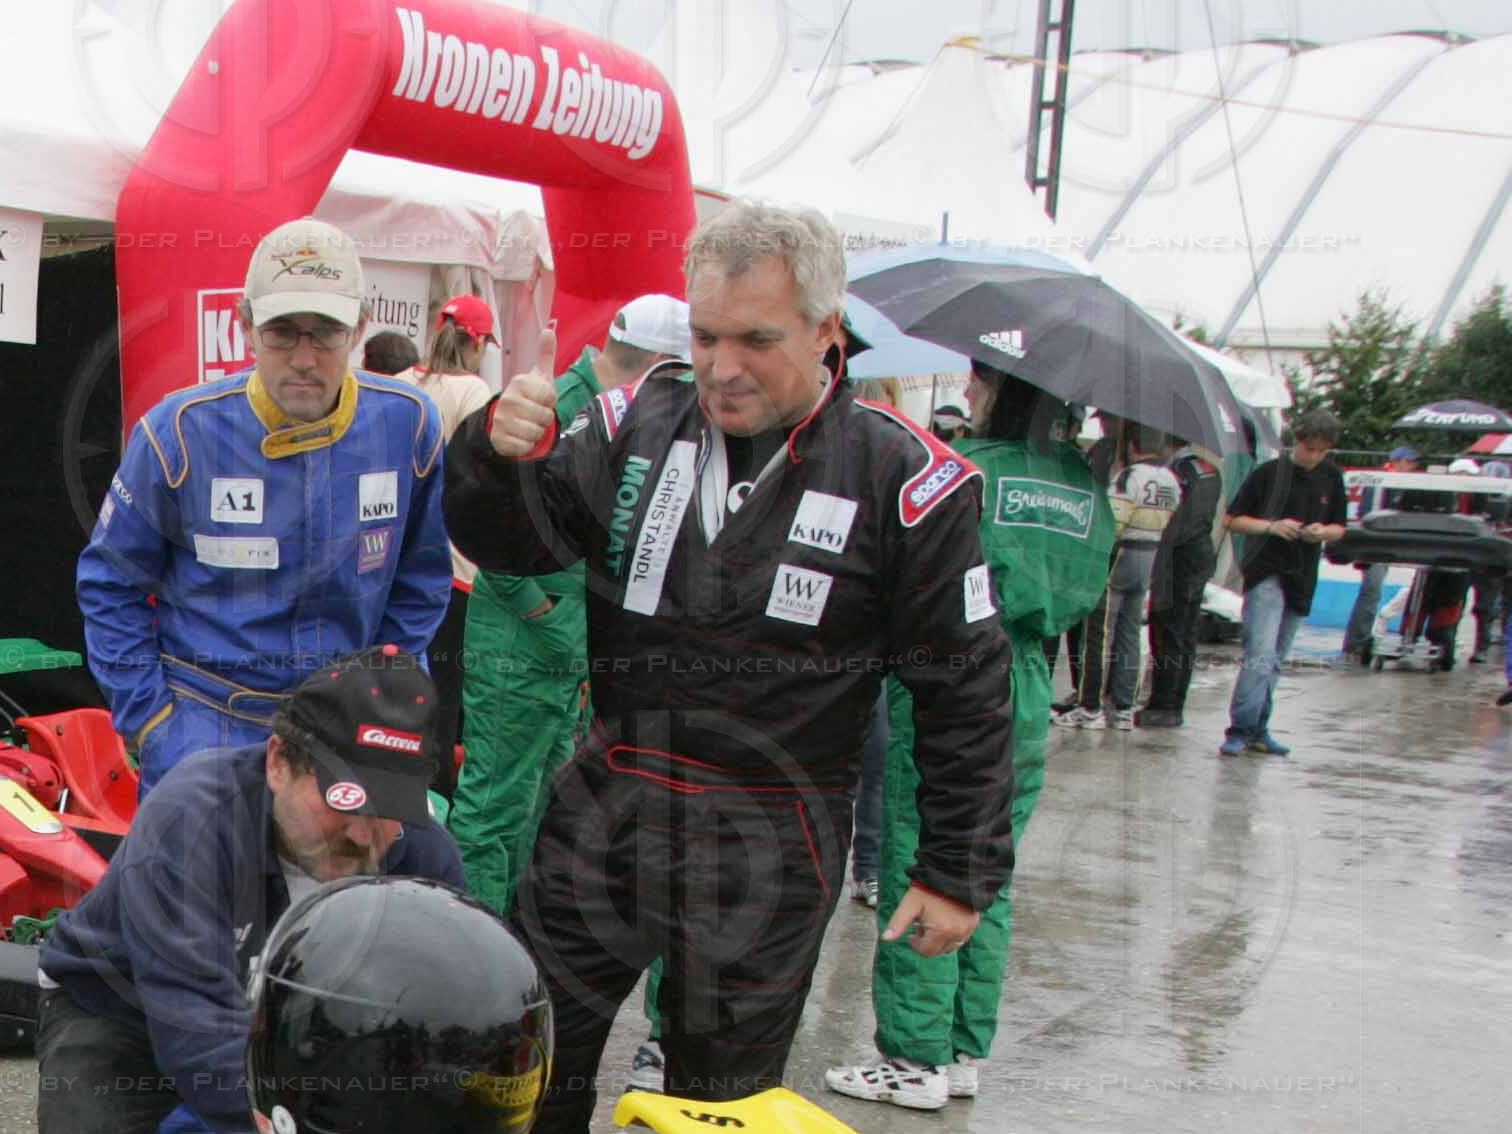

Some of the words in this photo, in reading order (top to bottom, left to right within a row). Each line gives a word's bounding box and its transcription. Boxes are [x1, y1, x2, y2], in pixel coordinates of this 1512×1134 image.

[392, 7, 536, 126] Kronen
[531, 44, 664, 161] Zeitung
[365, 284, 420, 337] itung
[910, 460, 962, 507] sparco
[633, 467, 680, 584] CHRISTANDL
[793, 523, 843, 548] KAPO
[363, 729, 421, 751] Carrera
